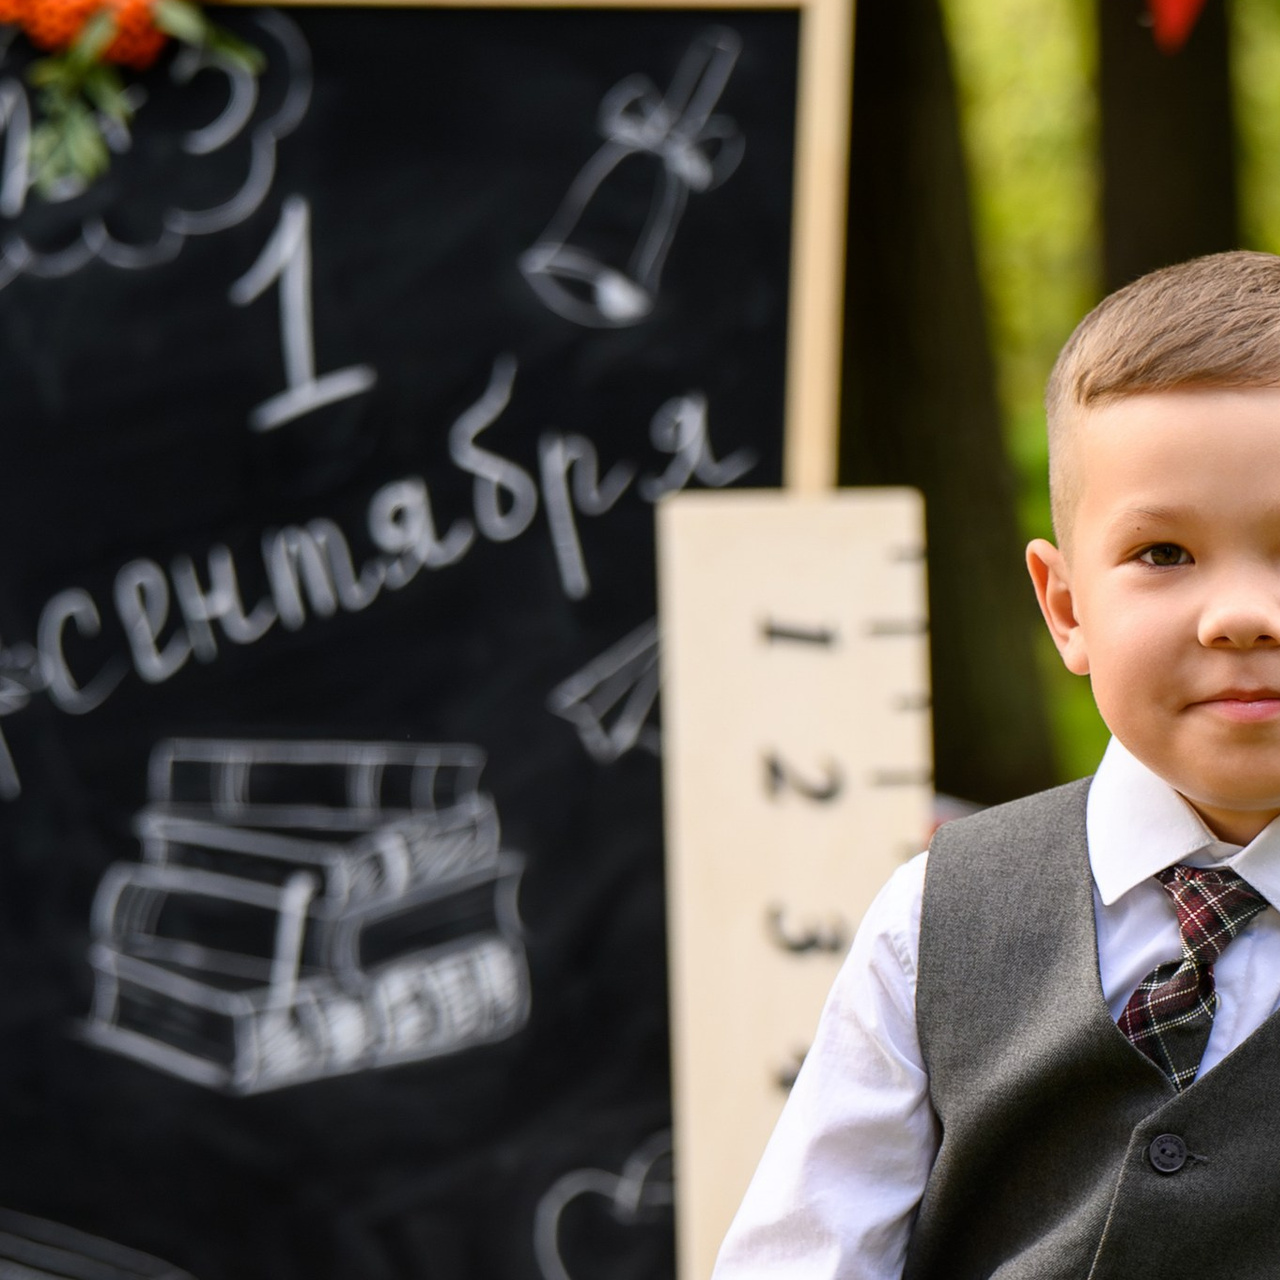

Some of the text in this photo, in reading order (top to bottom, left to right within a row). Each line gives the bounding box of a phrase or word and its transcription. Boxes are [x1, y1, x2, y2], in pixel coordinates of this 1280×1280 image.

[229, 195, 378, 431] 1
[37, 351, 760, 716] сентября
[762, 611, 842, 653] 1
[762, 748, 844, 806] 2
[765, 902, 848, 957] 3
